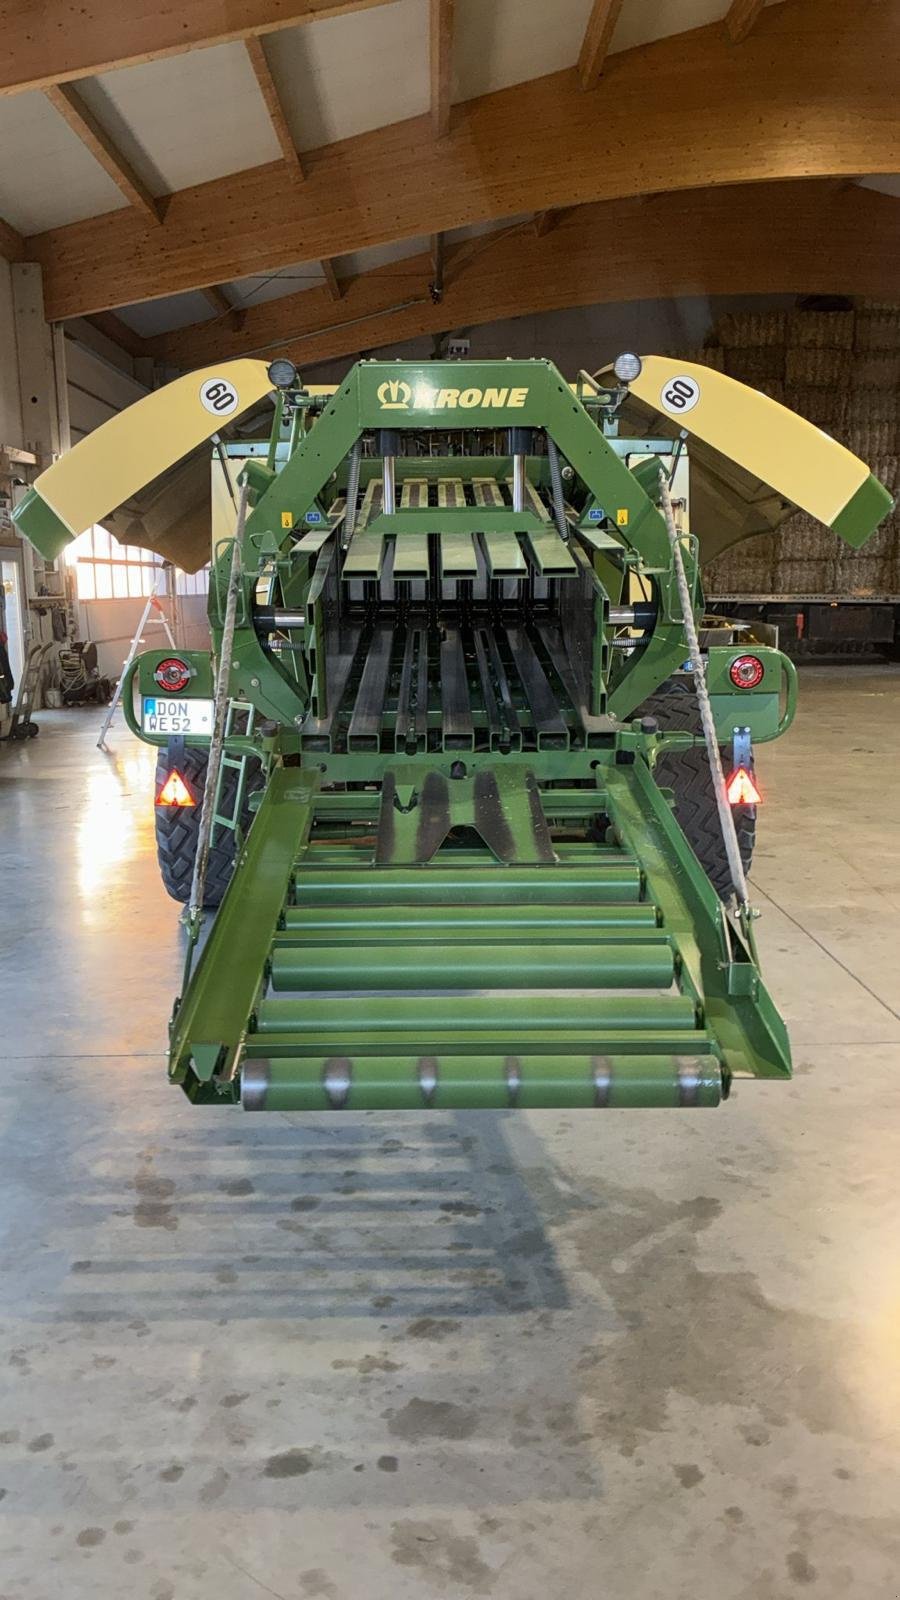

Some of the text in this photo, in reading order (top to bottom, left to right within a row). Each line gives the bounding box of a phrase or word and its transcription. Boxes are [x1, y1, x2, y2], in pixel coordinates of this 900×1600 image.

[206, 383, 235, 411] 60
[413, 387, 529, 409] KRONE
[665, 380, 694, 408] 60
[157, 702, 188, 716] DON
